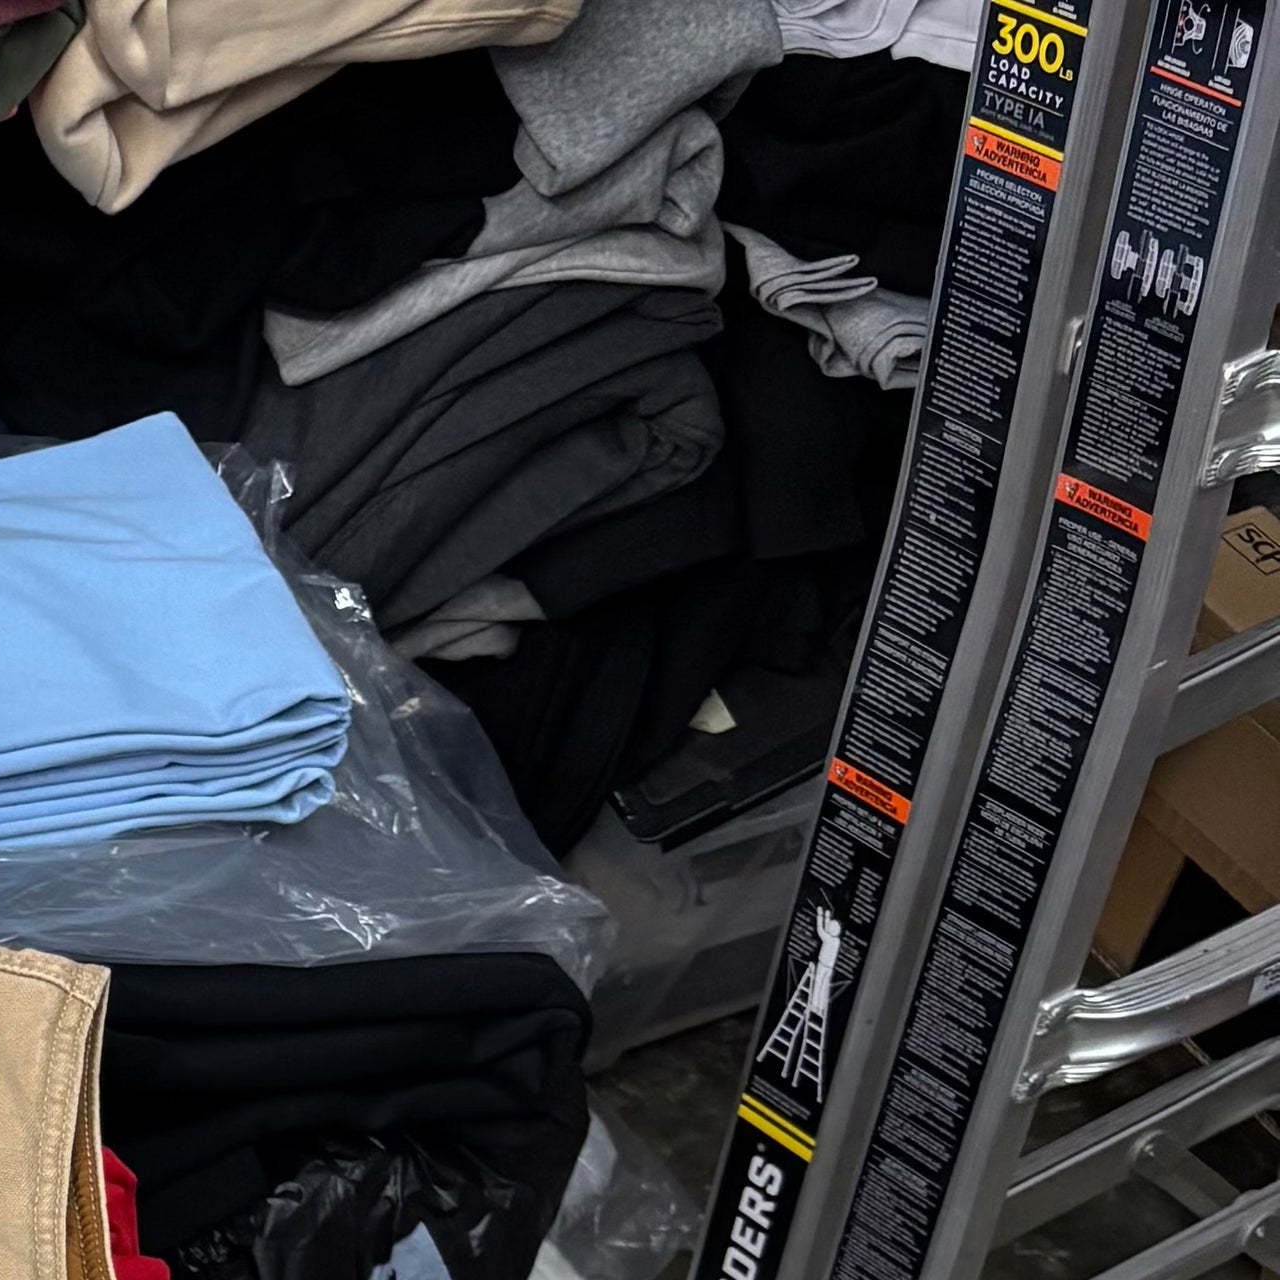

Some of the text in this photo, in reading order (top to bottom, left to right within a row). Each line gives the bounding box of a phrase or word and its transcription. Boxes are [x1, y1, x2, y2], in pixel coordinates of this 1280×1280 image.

[992, 13, 1073, 81] 300 LB
[990, 55, 1030, 80] LOAD
[984, 90, 1024, 120] TYPE
[988, 70, 1064, 109] CAPACITY
[983, 149, 1047, 183] ADVERTENCIA
[996, 141, 1040, 167] WARNING
